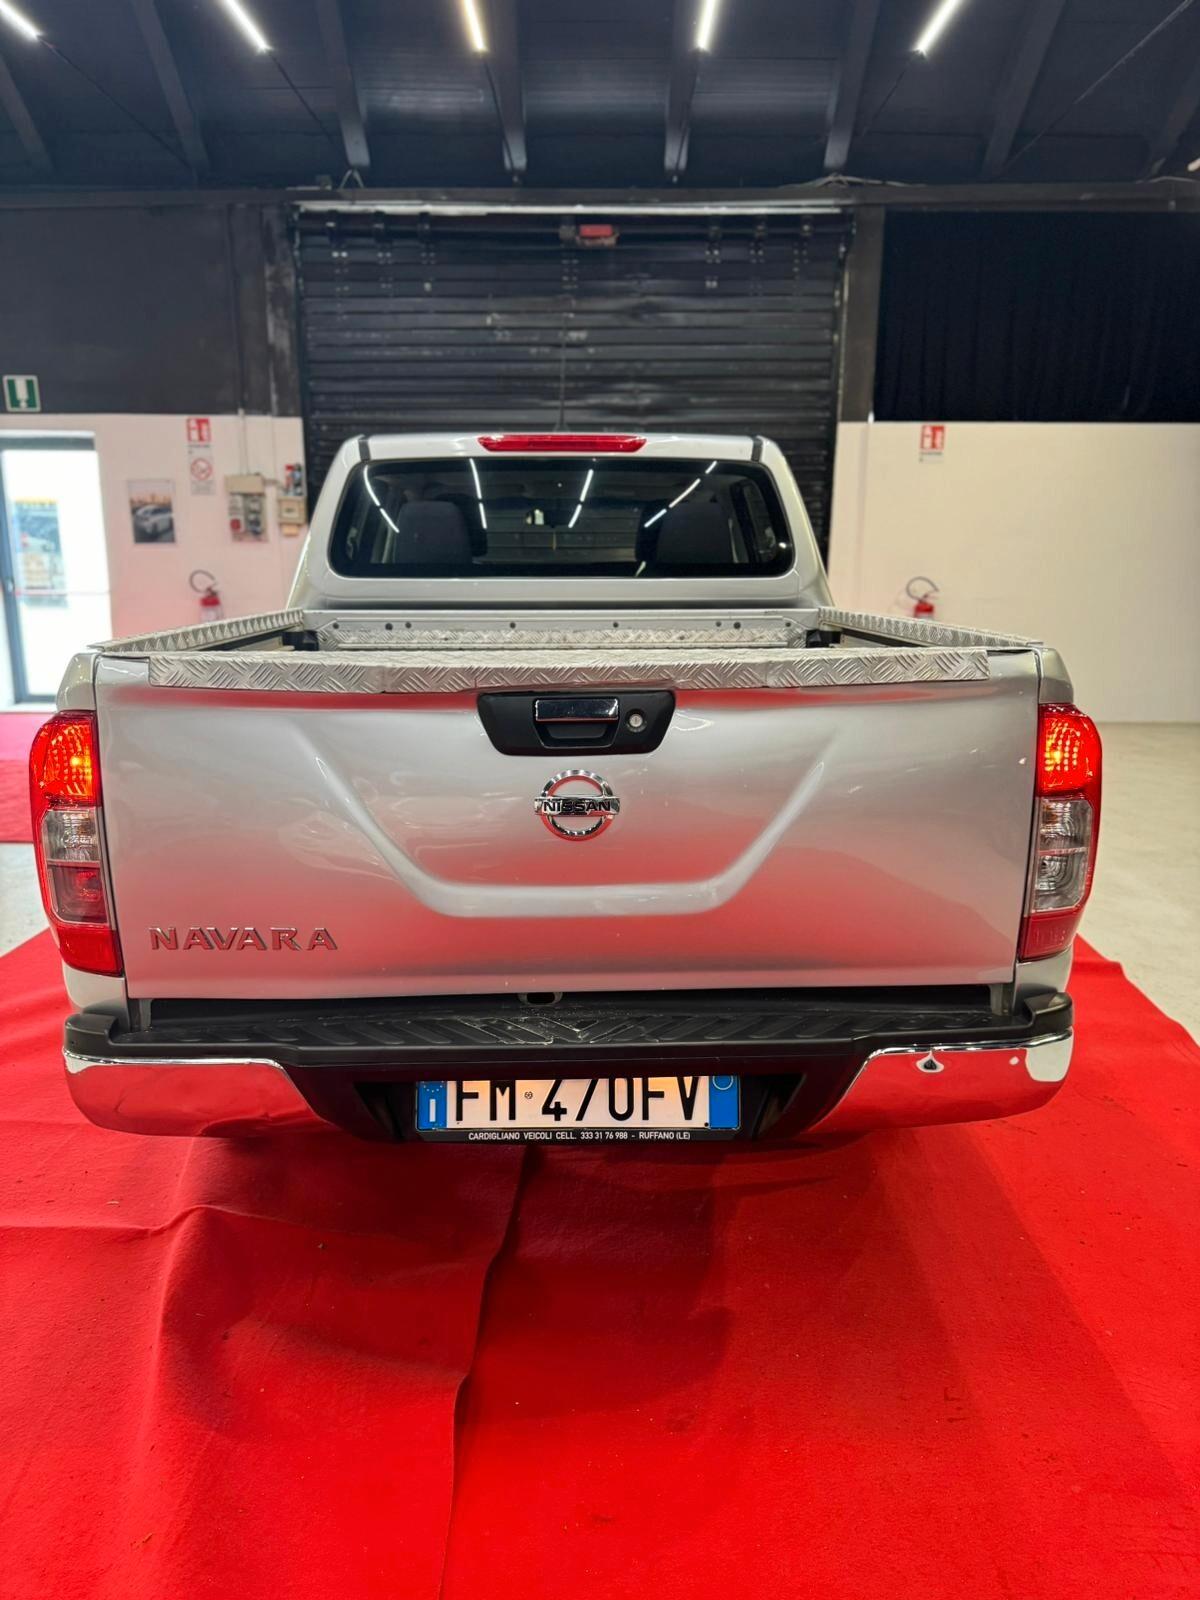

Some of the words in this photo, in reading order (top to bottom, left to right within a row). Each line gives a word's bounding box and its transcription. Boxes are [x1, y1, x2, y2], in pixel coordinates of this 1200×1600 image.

[543, 801, 611, 812] NISSAN
[149, 927, 338, 951] NAVARA
[456, 1080, 517, 1122] FM
[468, 1132, 520, 1141] CARDIGLIANO
[524, 1132, 553, 1140] VEICOLI
[556, 1132, 577, 1140] CELL.
[580, 1131, 594, 1140] 333
[594, 1131, 603, 1140] 31
[605, 1131, 614, 1140] 76
[615, 1131, 628, 1140] 988
[639, 1131, 675, 1140] RUFFANO
[676, 1131, 691, 1140] (LE)
